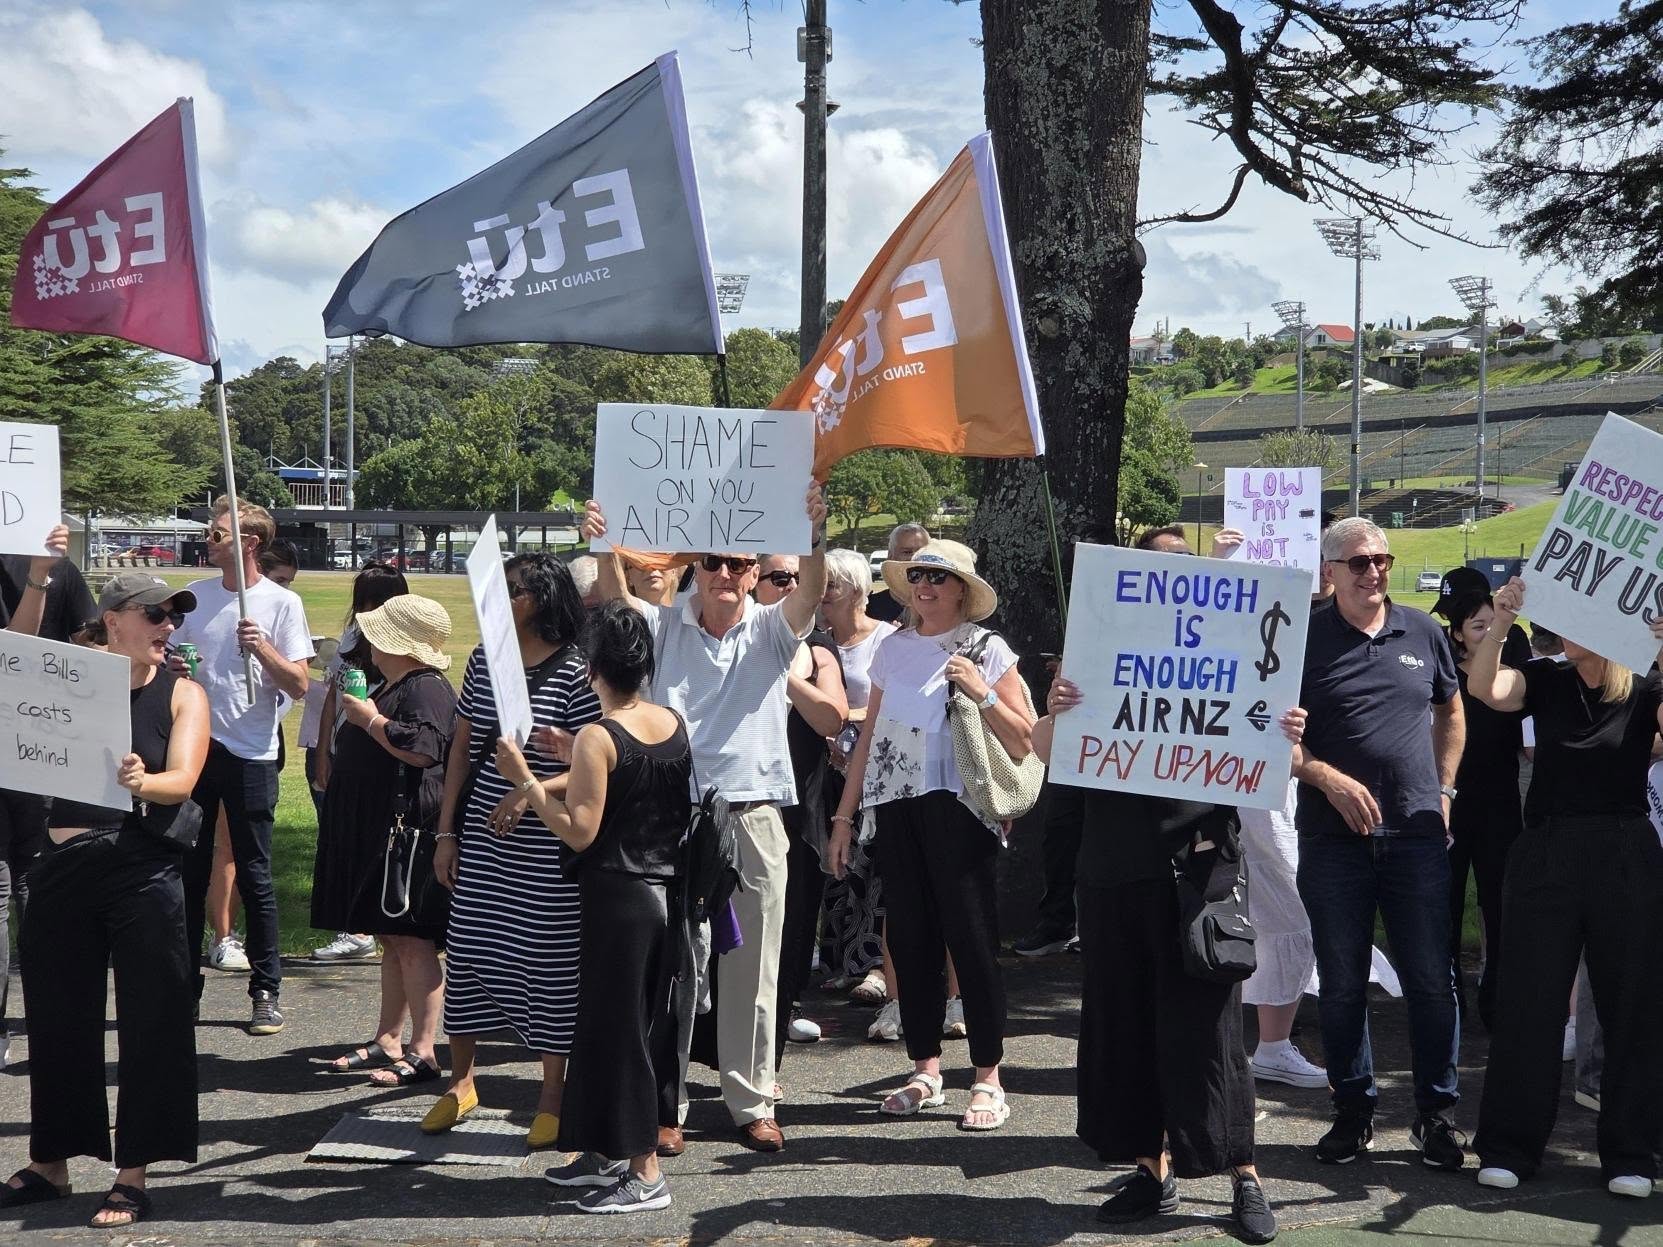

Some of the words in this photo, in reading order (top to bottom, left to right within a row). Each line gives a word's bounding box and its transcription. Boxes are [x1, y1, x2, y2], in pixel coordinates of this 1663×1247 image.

[629, 410, 777, 470] SHAME
[656, 478, 694, 506] ON
[709, 478, 754, 504] YOU
[1243, 471, 1303, 498] LOW
[621, 505, 693, 547] AIR
[711, 509, 765, 547] NZ
[1252, 499, 1289, 521] PAY
[1563, 489, 1658, 559] VALUE
[1247, 538, 1289, 559] NOT
[1534, 527, 1625, 597] PAY
[1116, 570, 1259, 614] ENOUGH
[42, 653, 80, 682] Bills
[1113, 653, 1238, 694] ENOUGH
[17, 701, 72, 723] costs
[16, 734, 69, 767] behind
[1078, 736, 1144, 780] PAY
